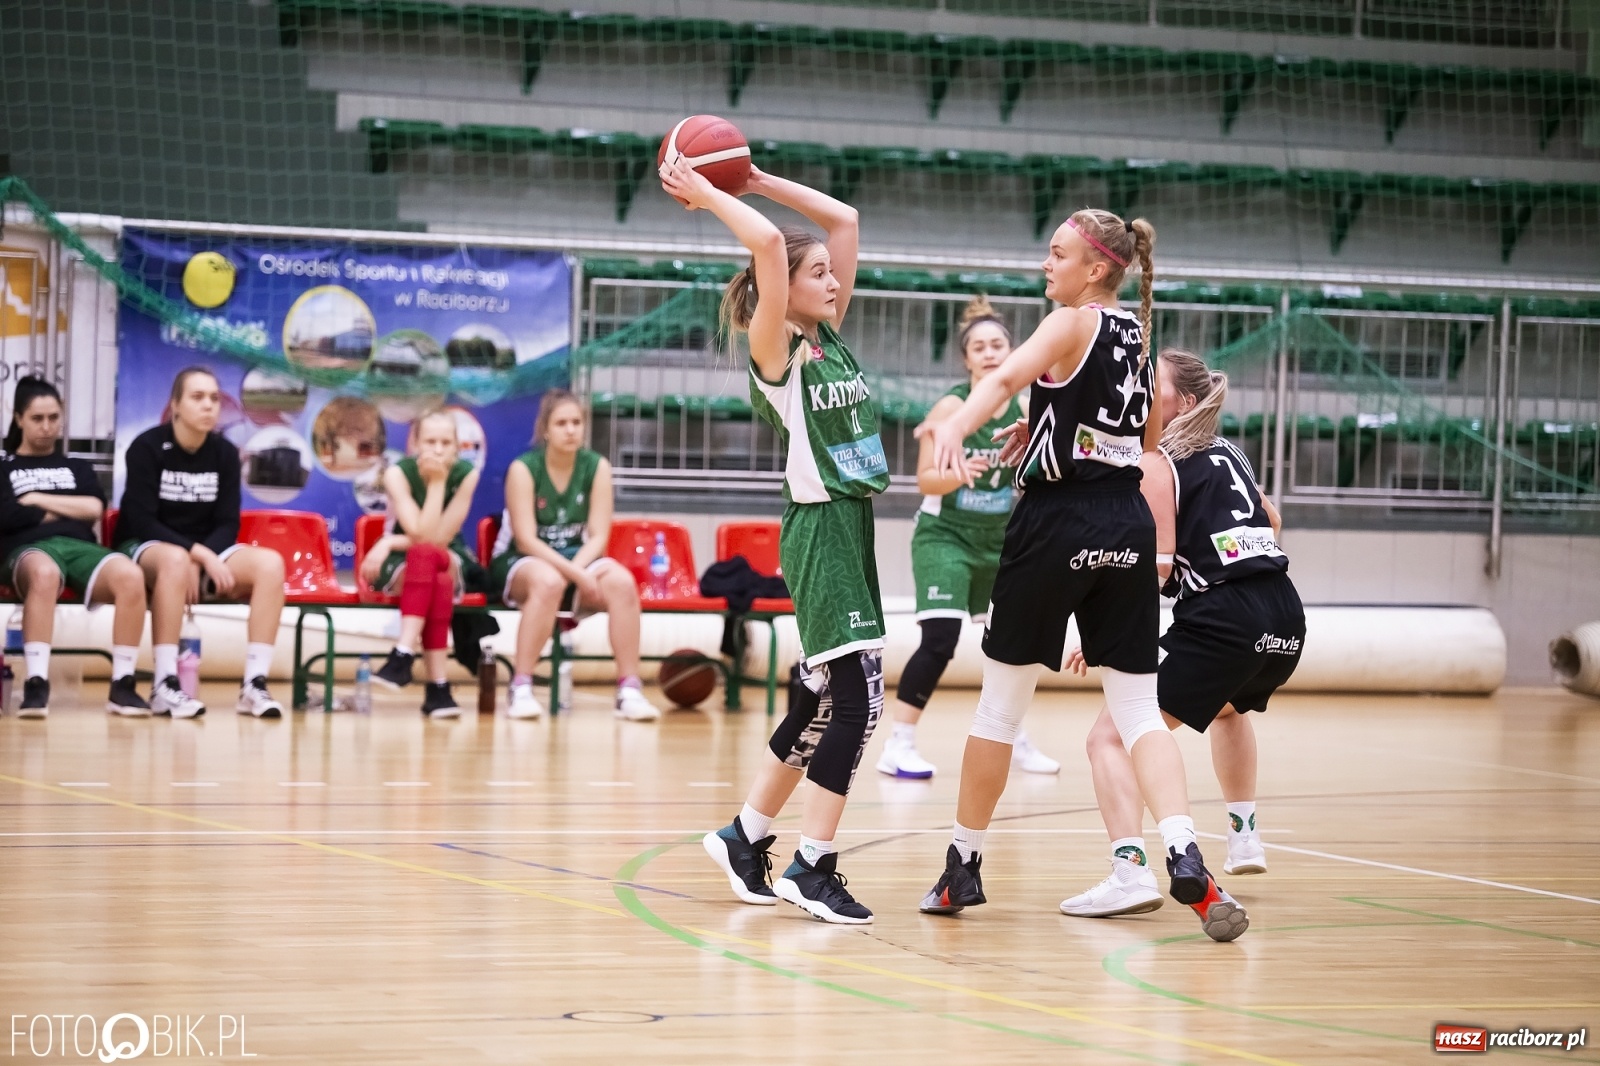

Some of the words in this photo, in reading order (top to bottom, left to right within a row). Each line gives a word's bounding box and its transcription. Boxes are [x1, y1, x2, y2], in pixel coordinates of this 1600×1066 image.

[833, 446, 864, 462] max
[1209, 454, 1254, 521] 3
[1087, 548, 1139, 566] Clavis
